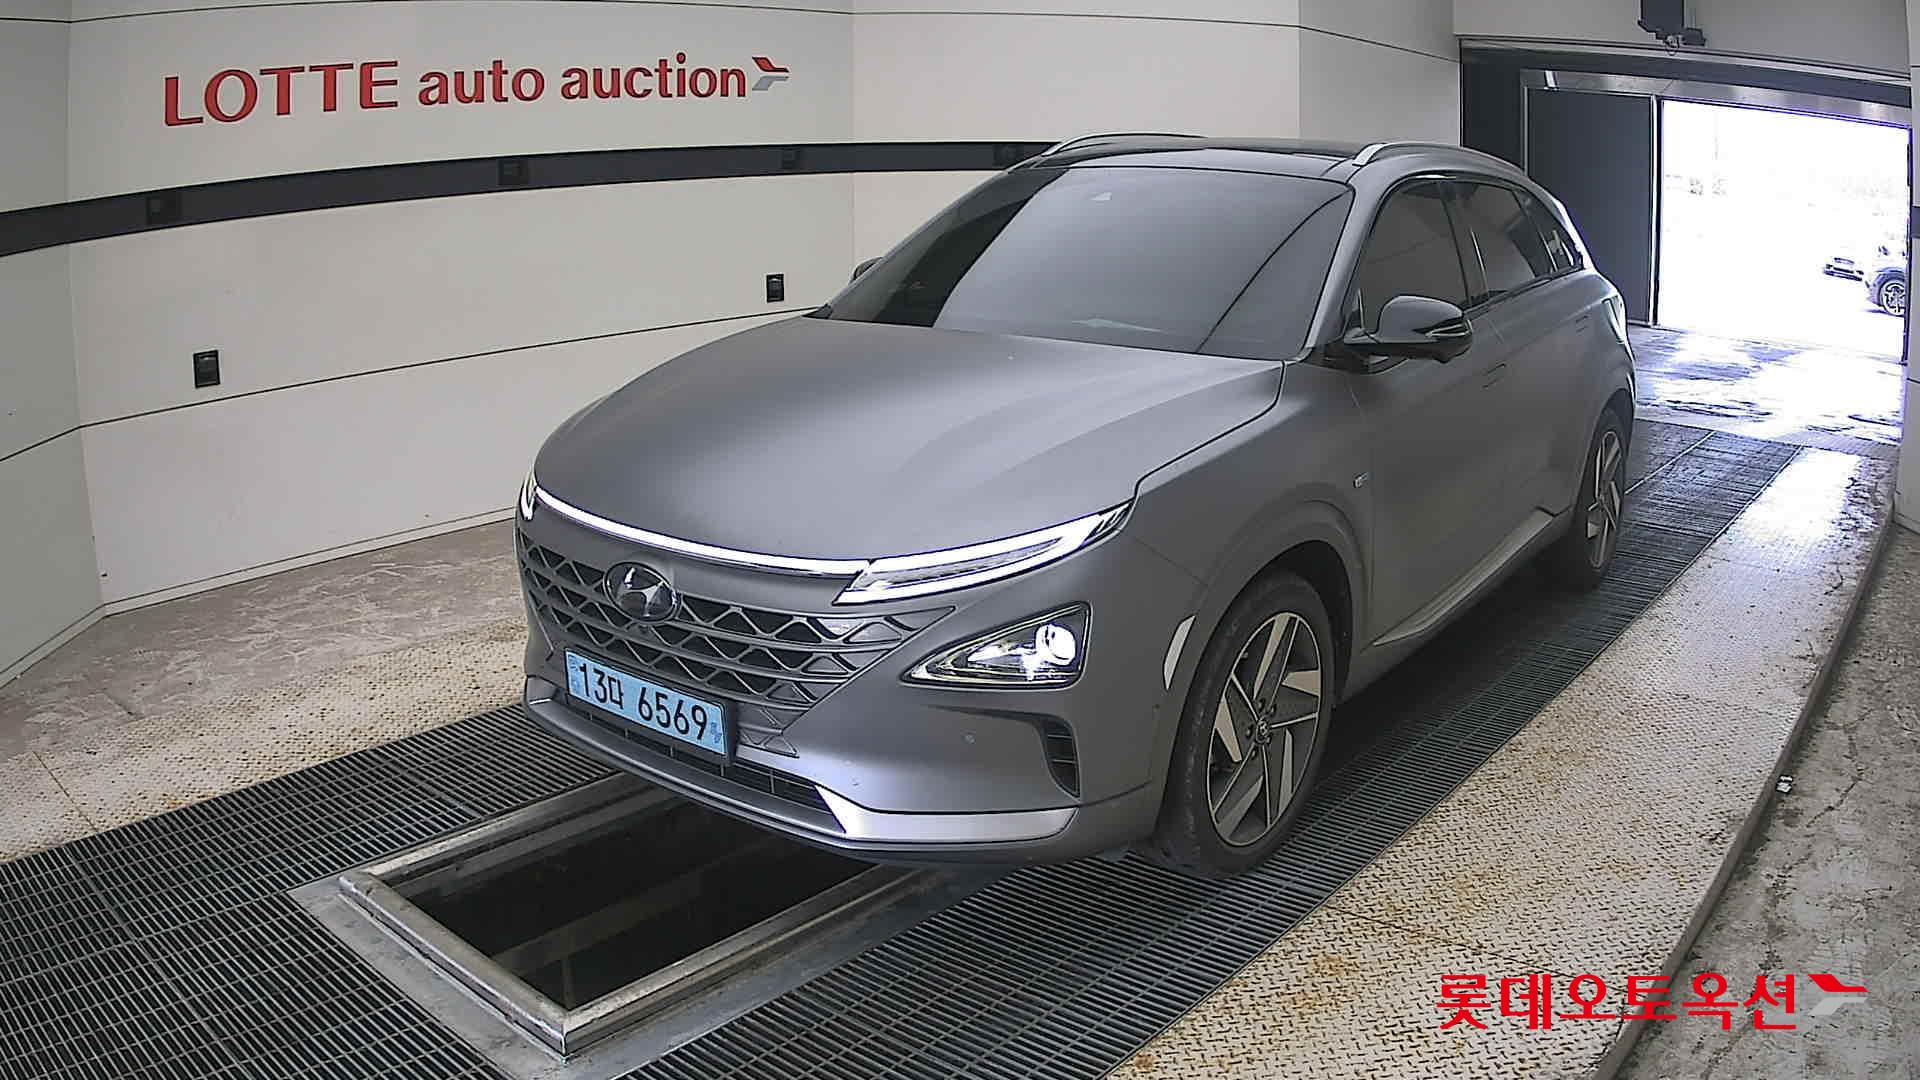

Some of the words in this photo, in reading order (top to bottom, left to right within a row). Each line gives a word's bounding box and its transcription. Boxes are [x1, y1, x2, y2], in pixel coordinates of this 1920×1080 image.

[164, 60, 399, 126] LOTTE
[418, 60, 546, 106] auto
[560, 53, 747, 99] auction
[579, 663, 625, 710] 13다
[638, 686, 708, 741] 6569
